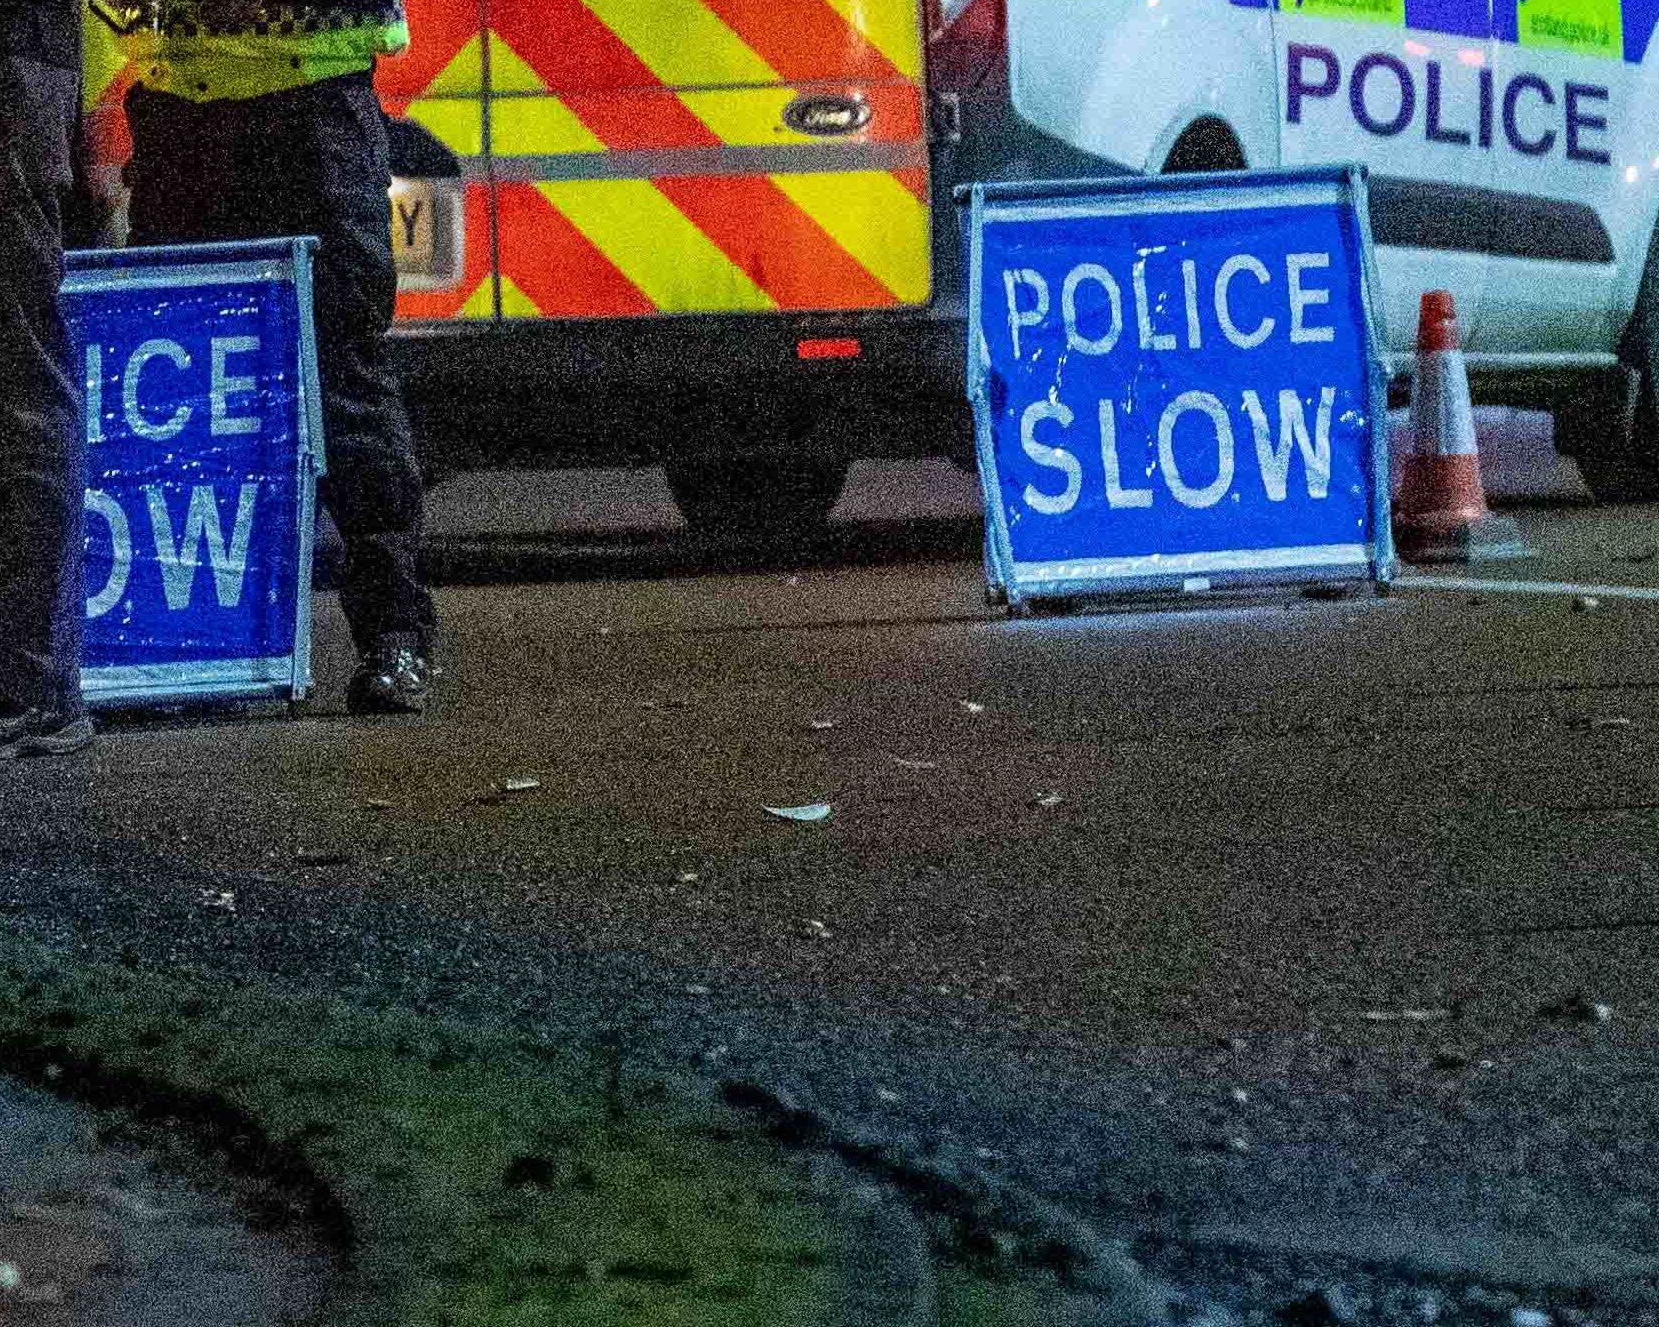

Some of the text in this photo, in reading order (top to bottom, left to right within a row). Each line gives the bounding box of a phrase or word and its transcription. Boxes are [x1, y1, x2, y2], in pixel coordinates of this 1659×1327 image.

[1285, 42, 1613, 166] POLICE
[1003, 251, 1336, 358] POLICE
[1020, 387, 1337, 515] SLOW
